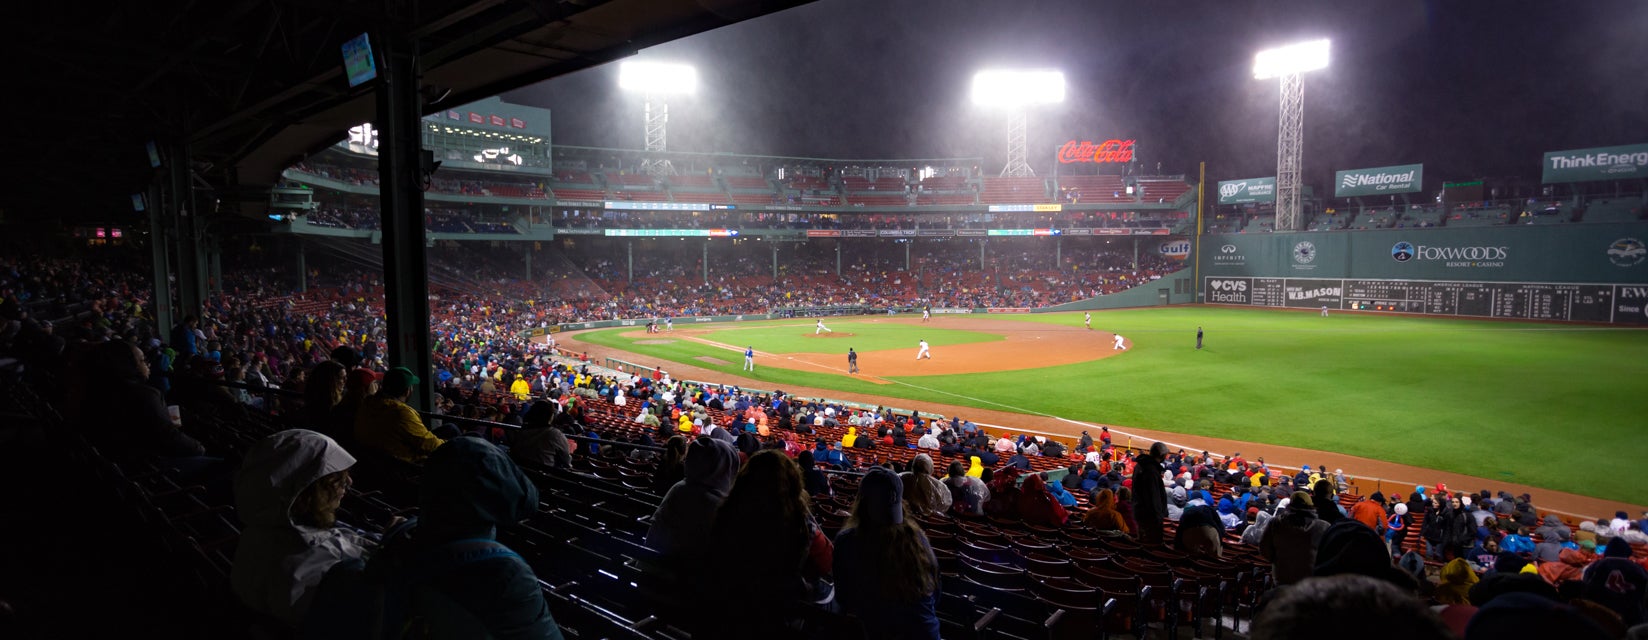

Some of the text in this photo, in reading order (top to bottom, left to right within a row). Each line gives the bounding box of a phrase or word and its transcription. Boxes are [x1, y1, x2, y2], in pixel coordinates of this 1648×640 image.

[1058, 139, 1136, 163] Coca-Cola
[1358, 170, 1414, 185] National
[1221, 184, 1238, 197] AAA
[1160, 243, 1189, 253] Gulf
[1417, 246, 1507, 260] FOXWOODS
[1222, 280, 1247, 291] CVS
[1212, 291, 1246, 302] Health
[1618, 305, 1640, 313] Since
